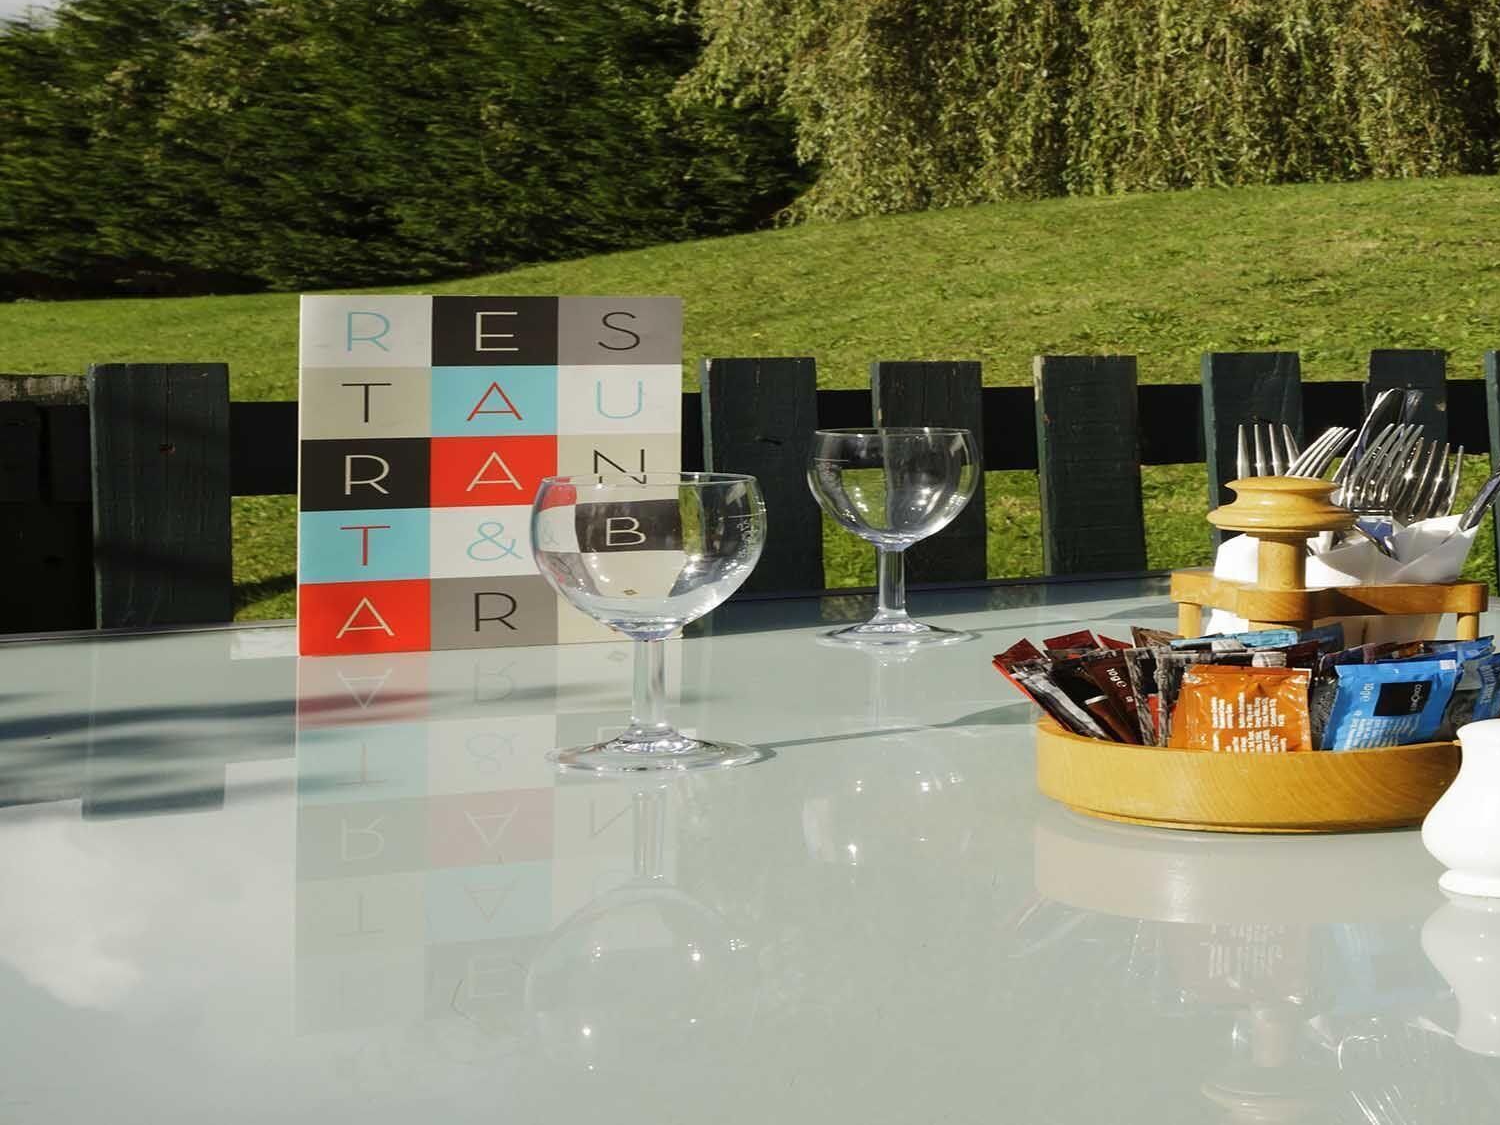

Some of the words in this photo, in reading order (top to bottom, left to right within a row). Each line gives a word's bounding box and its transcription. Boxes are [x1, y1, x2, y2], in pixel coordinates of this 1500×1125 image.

[346, 311, 391, 353] R
[475, 311, 519, 352] E
[597, 310, 641, 351] S
[341, 382, 392, 424] T
[466, 381, 524, 422] A
[595, 379, 644, 420] U
[344, 454, 391, 496] R
[465, 451, 524, 492] A
[592, 448, 647, 485] N
[340, 524, 391, 567] T
[466, 520, 524, 562] &
[606, 516, 647, 547] B
[336, 596, 395, 639] A
[473, 591, 518, 633] R
